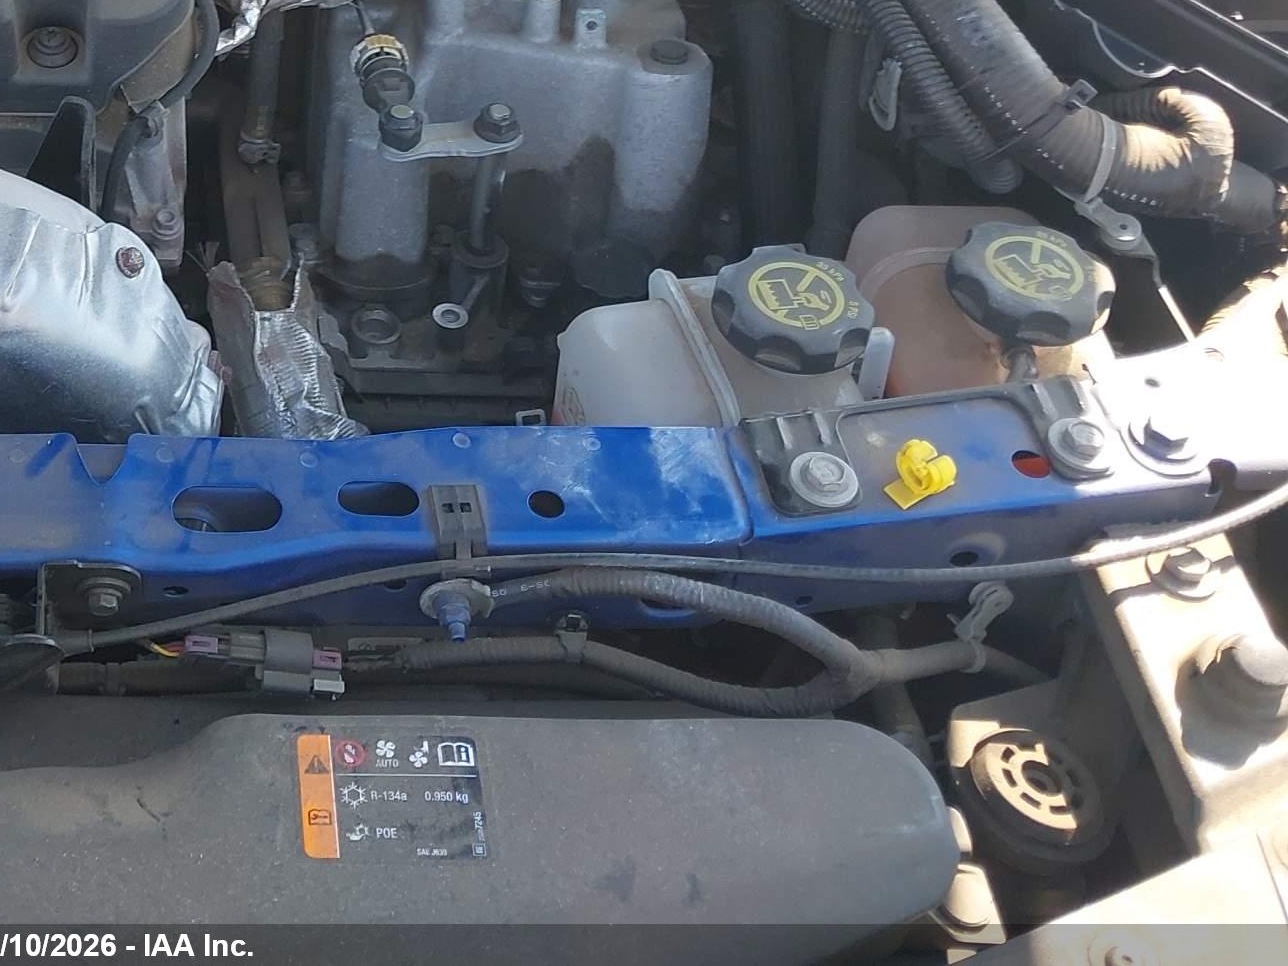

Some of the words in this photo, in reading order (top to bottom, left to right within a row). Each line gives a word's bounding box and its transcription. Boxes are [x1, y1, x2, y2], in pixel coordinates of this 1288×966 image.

[375, 758, 399, 768] AUTO
[370, 790, 408, 802] R-134a
[424, 791, 453, 802] 0.950
[455, 791, 469, 804] kg
[376, 827, 397, 839] POE
